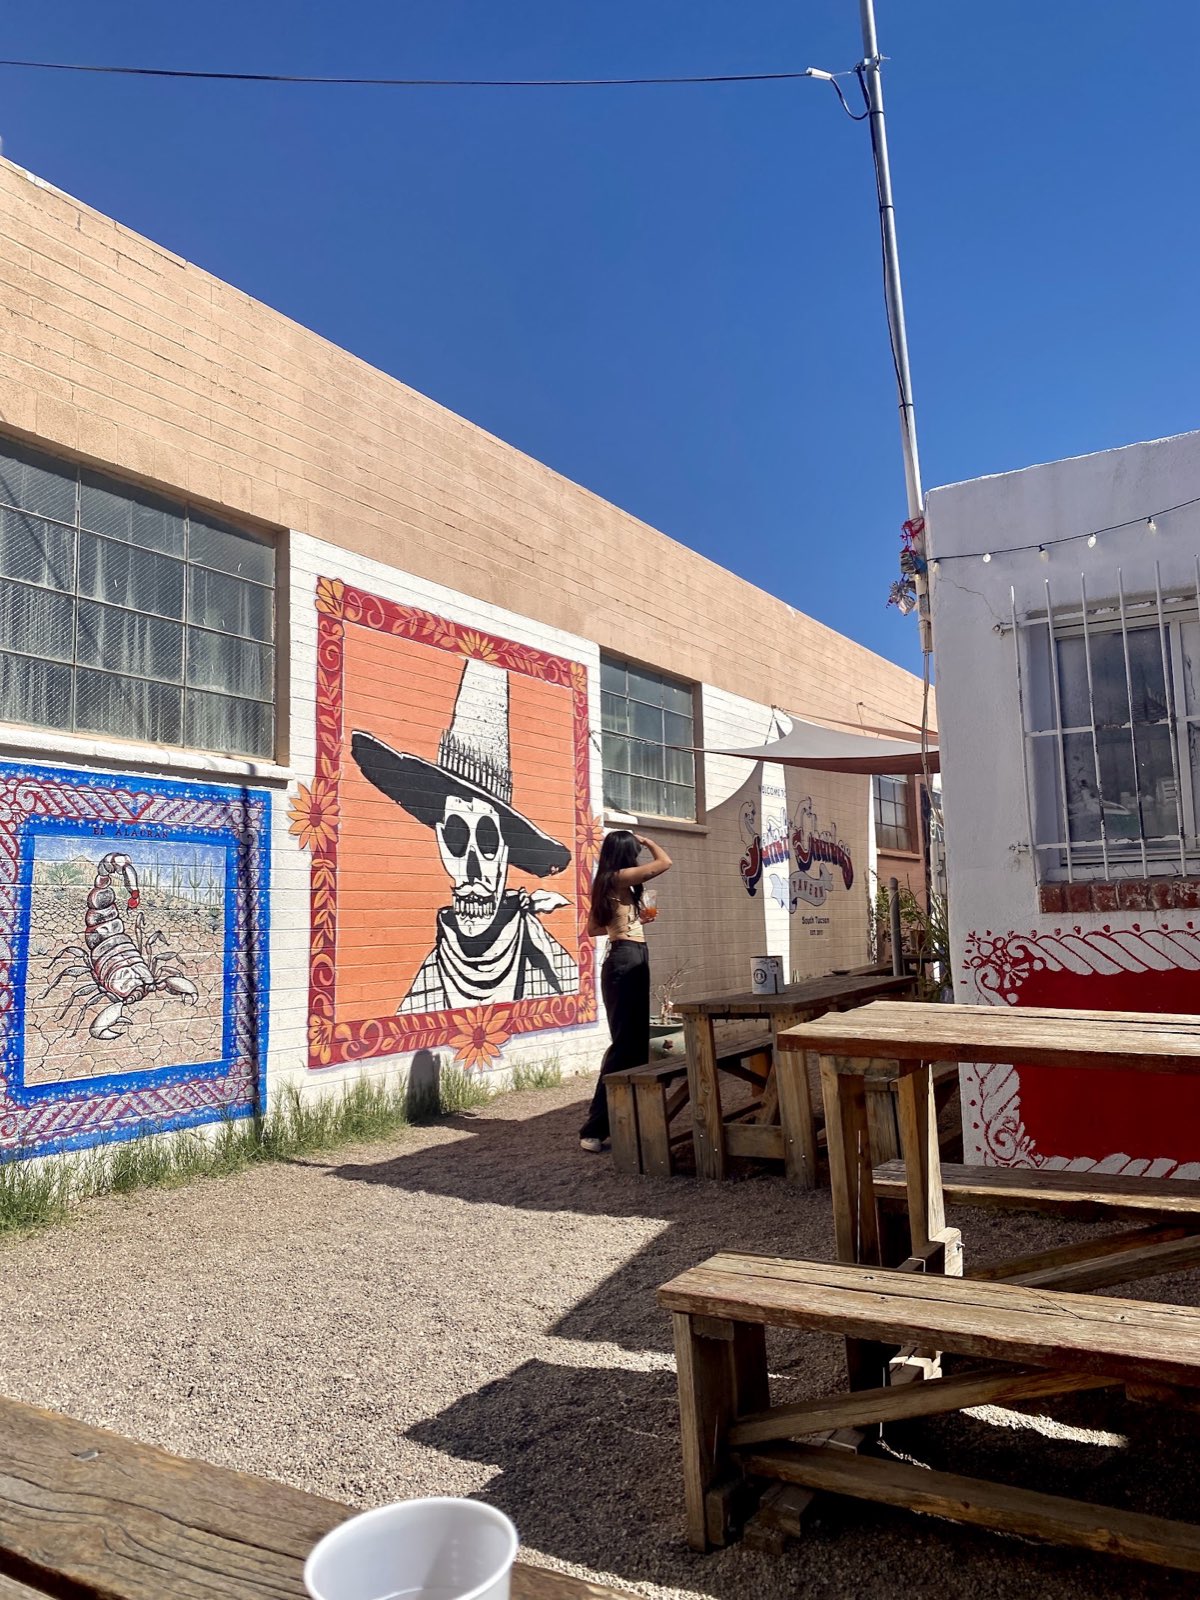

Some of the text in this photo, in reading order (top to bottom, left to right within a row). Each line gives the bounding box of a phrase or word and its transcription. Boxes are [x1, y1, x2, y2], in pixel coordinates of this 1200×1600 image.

[93, 827, 168, 839] EL ALACRAN
[792, 880, 824, 898] TAVERN
[802, 916, 830, 925] South Tucson
